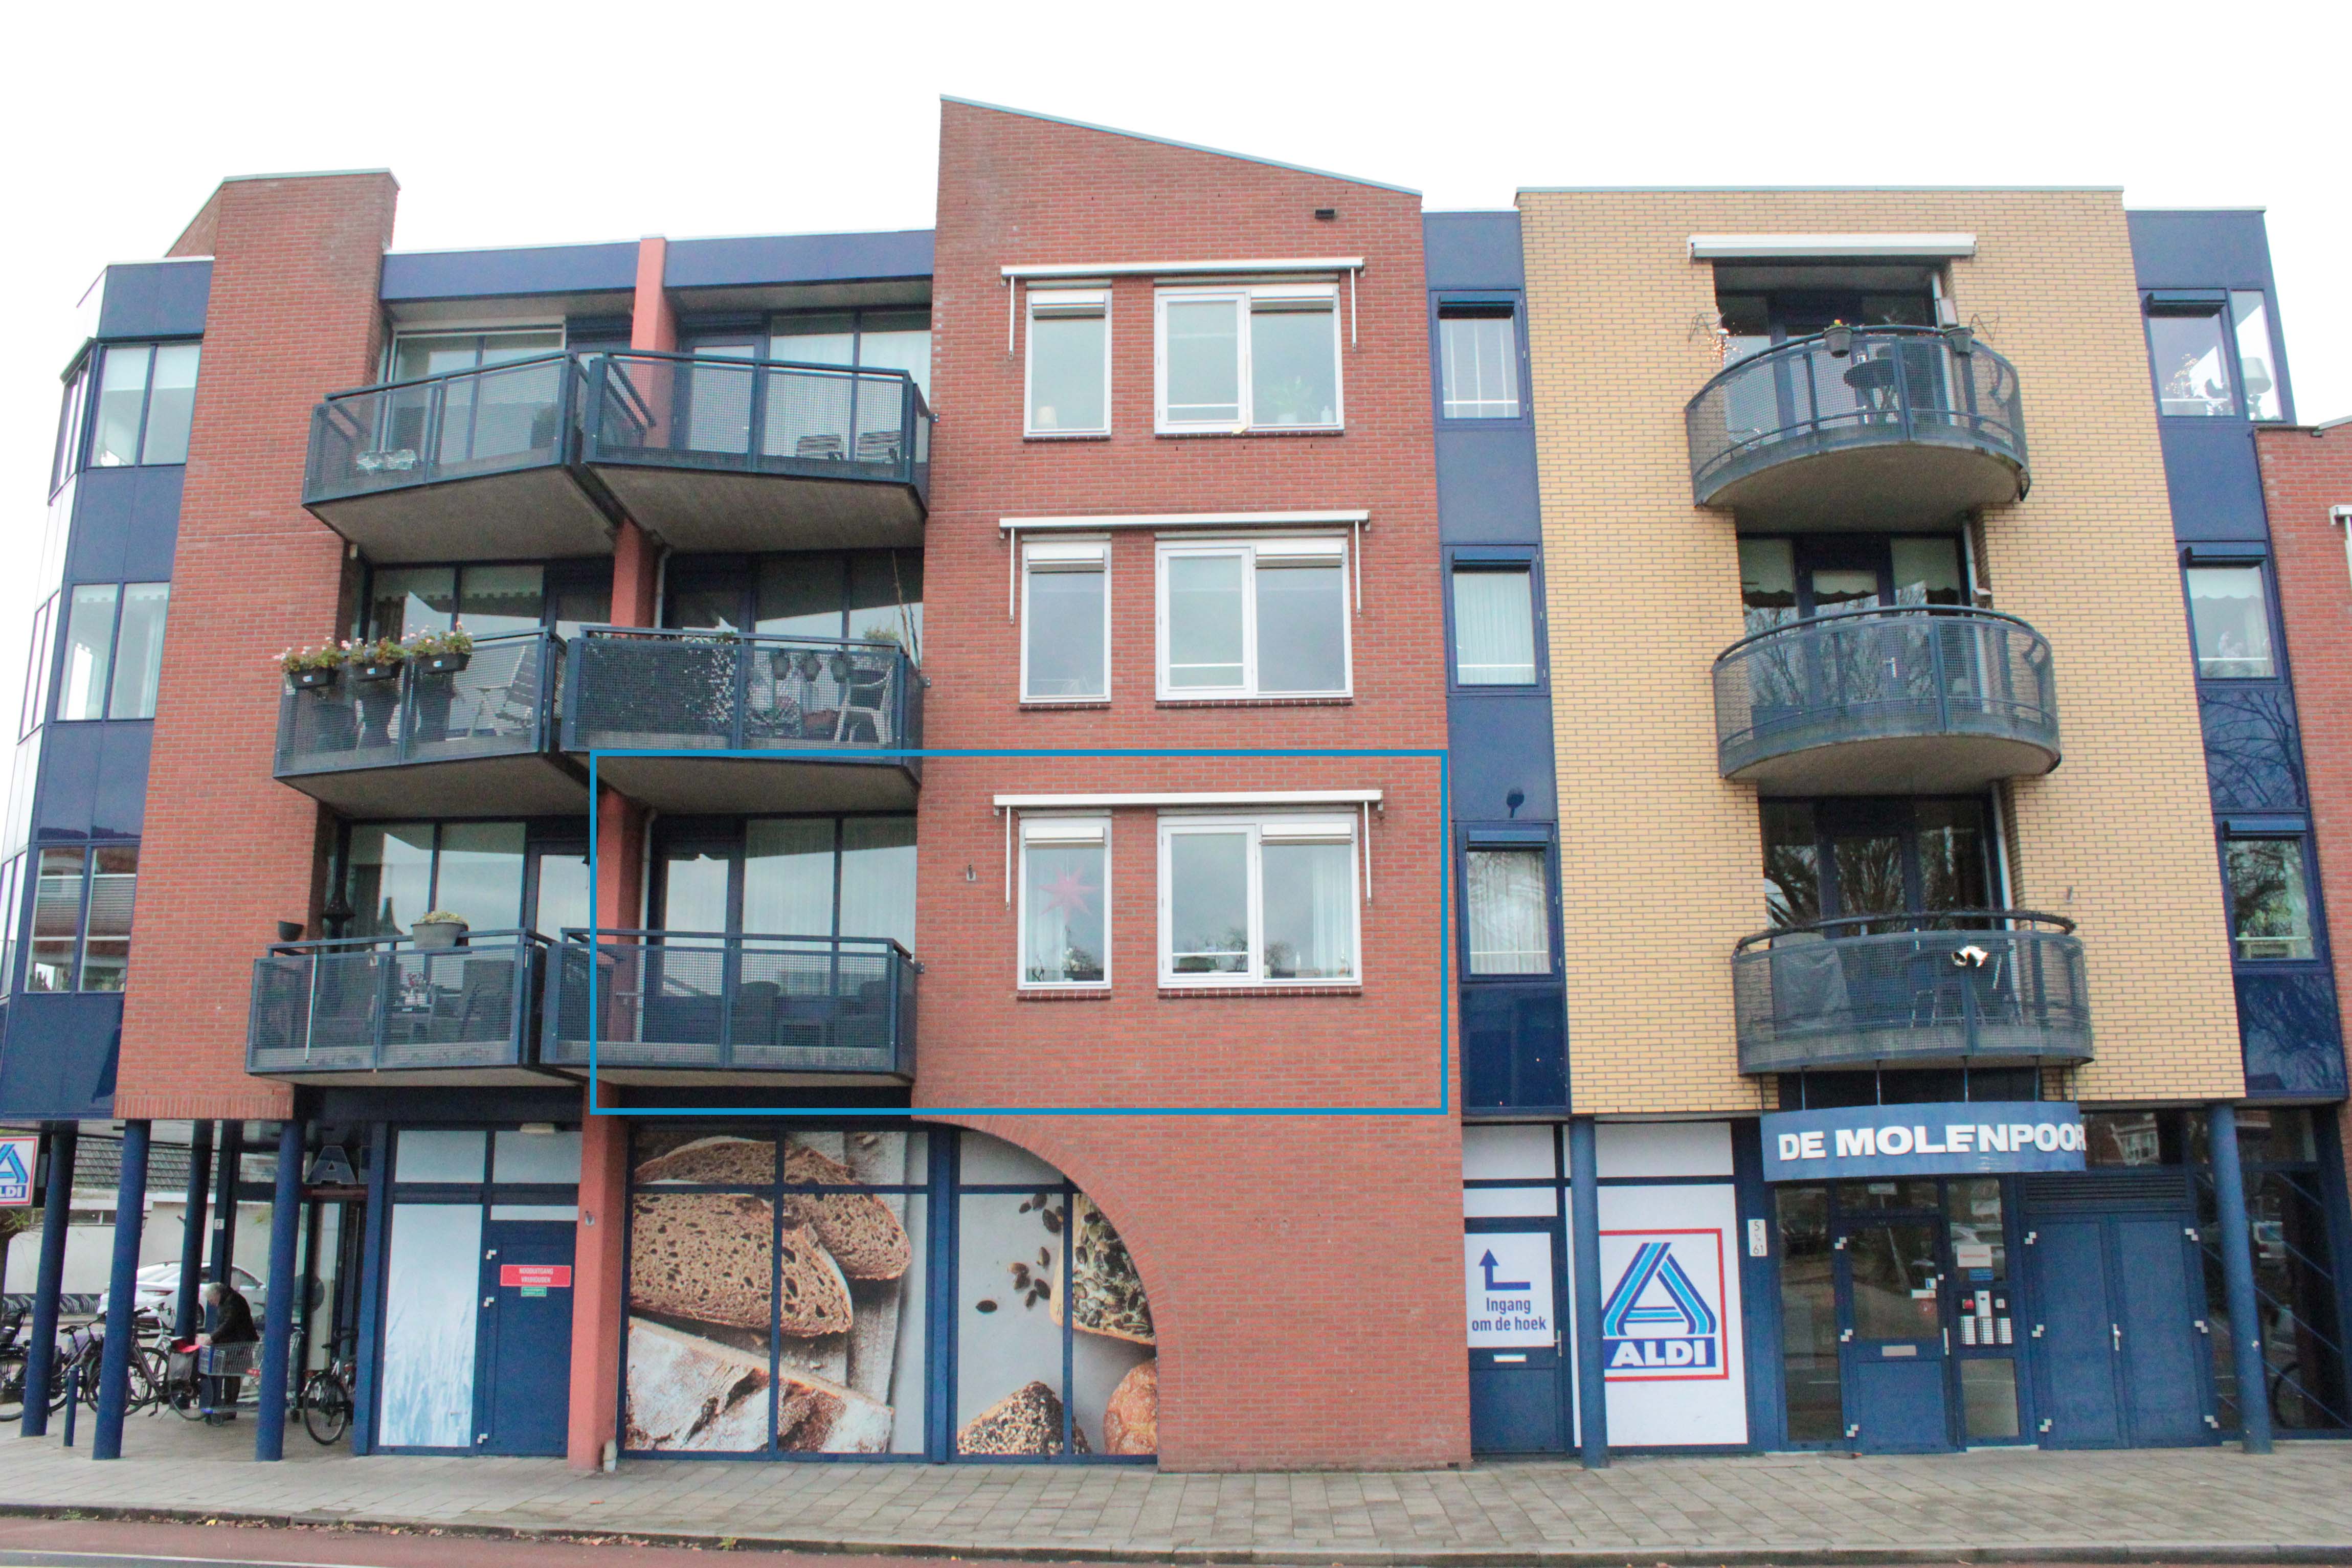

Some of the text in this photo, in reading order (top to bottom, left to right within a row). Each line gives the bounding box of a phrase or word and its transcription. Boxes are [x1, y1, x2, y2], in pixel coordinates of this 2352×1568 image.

[1778, 1131, 1826, 1161] DE
[0, 1186, 23, 1198] LDI
[216, 1220, 222, 1228] 2
[1755, 1221, 1760, 1231] 5
[1753, 1244, 1763, 1255] 61
[1486, 1297, 1531, 1315] Ingang
[1472, 1316, 1547, 1331] om de hoek
[1610, 1339, 1707, 1367] ALDI
